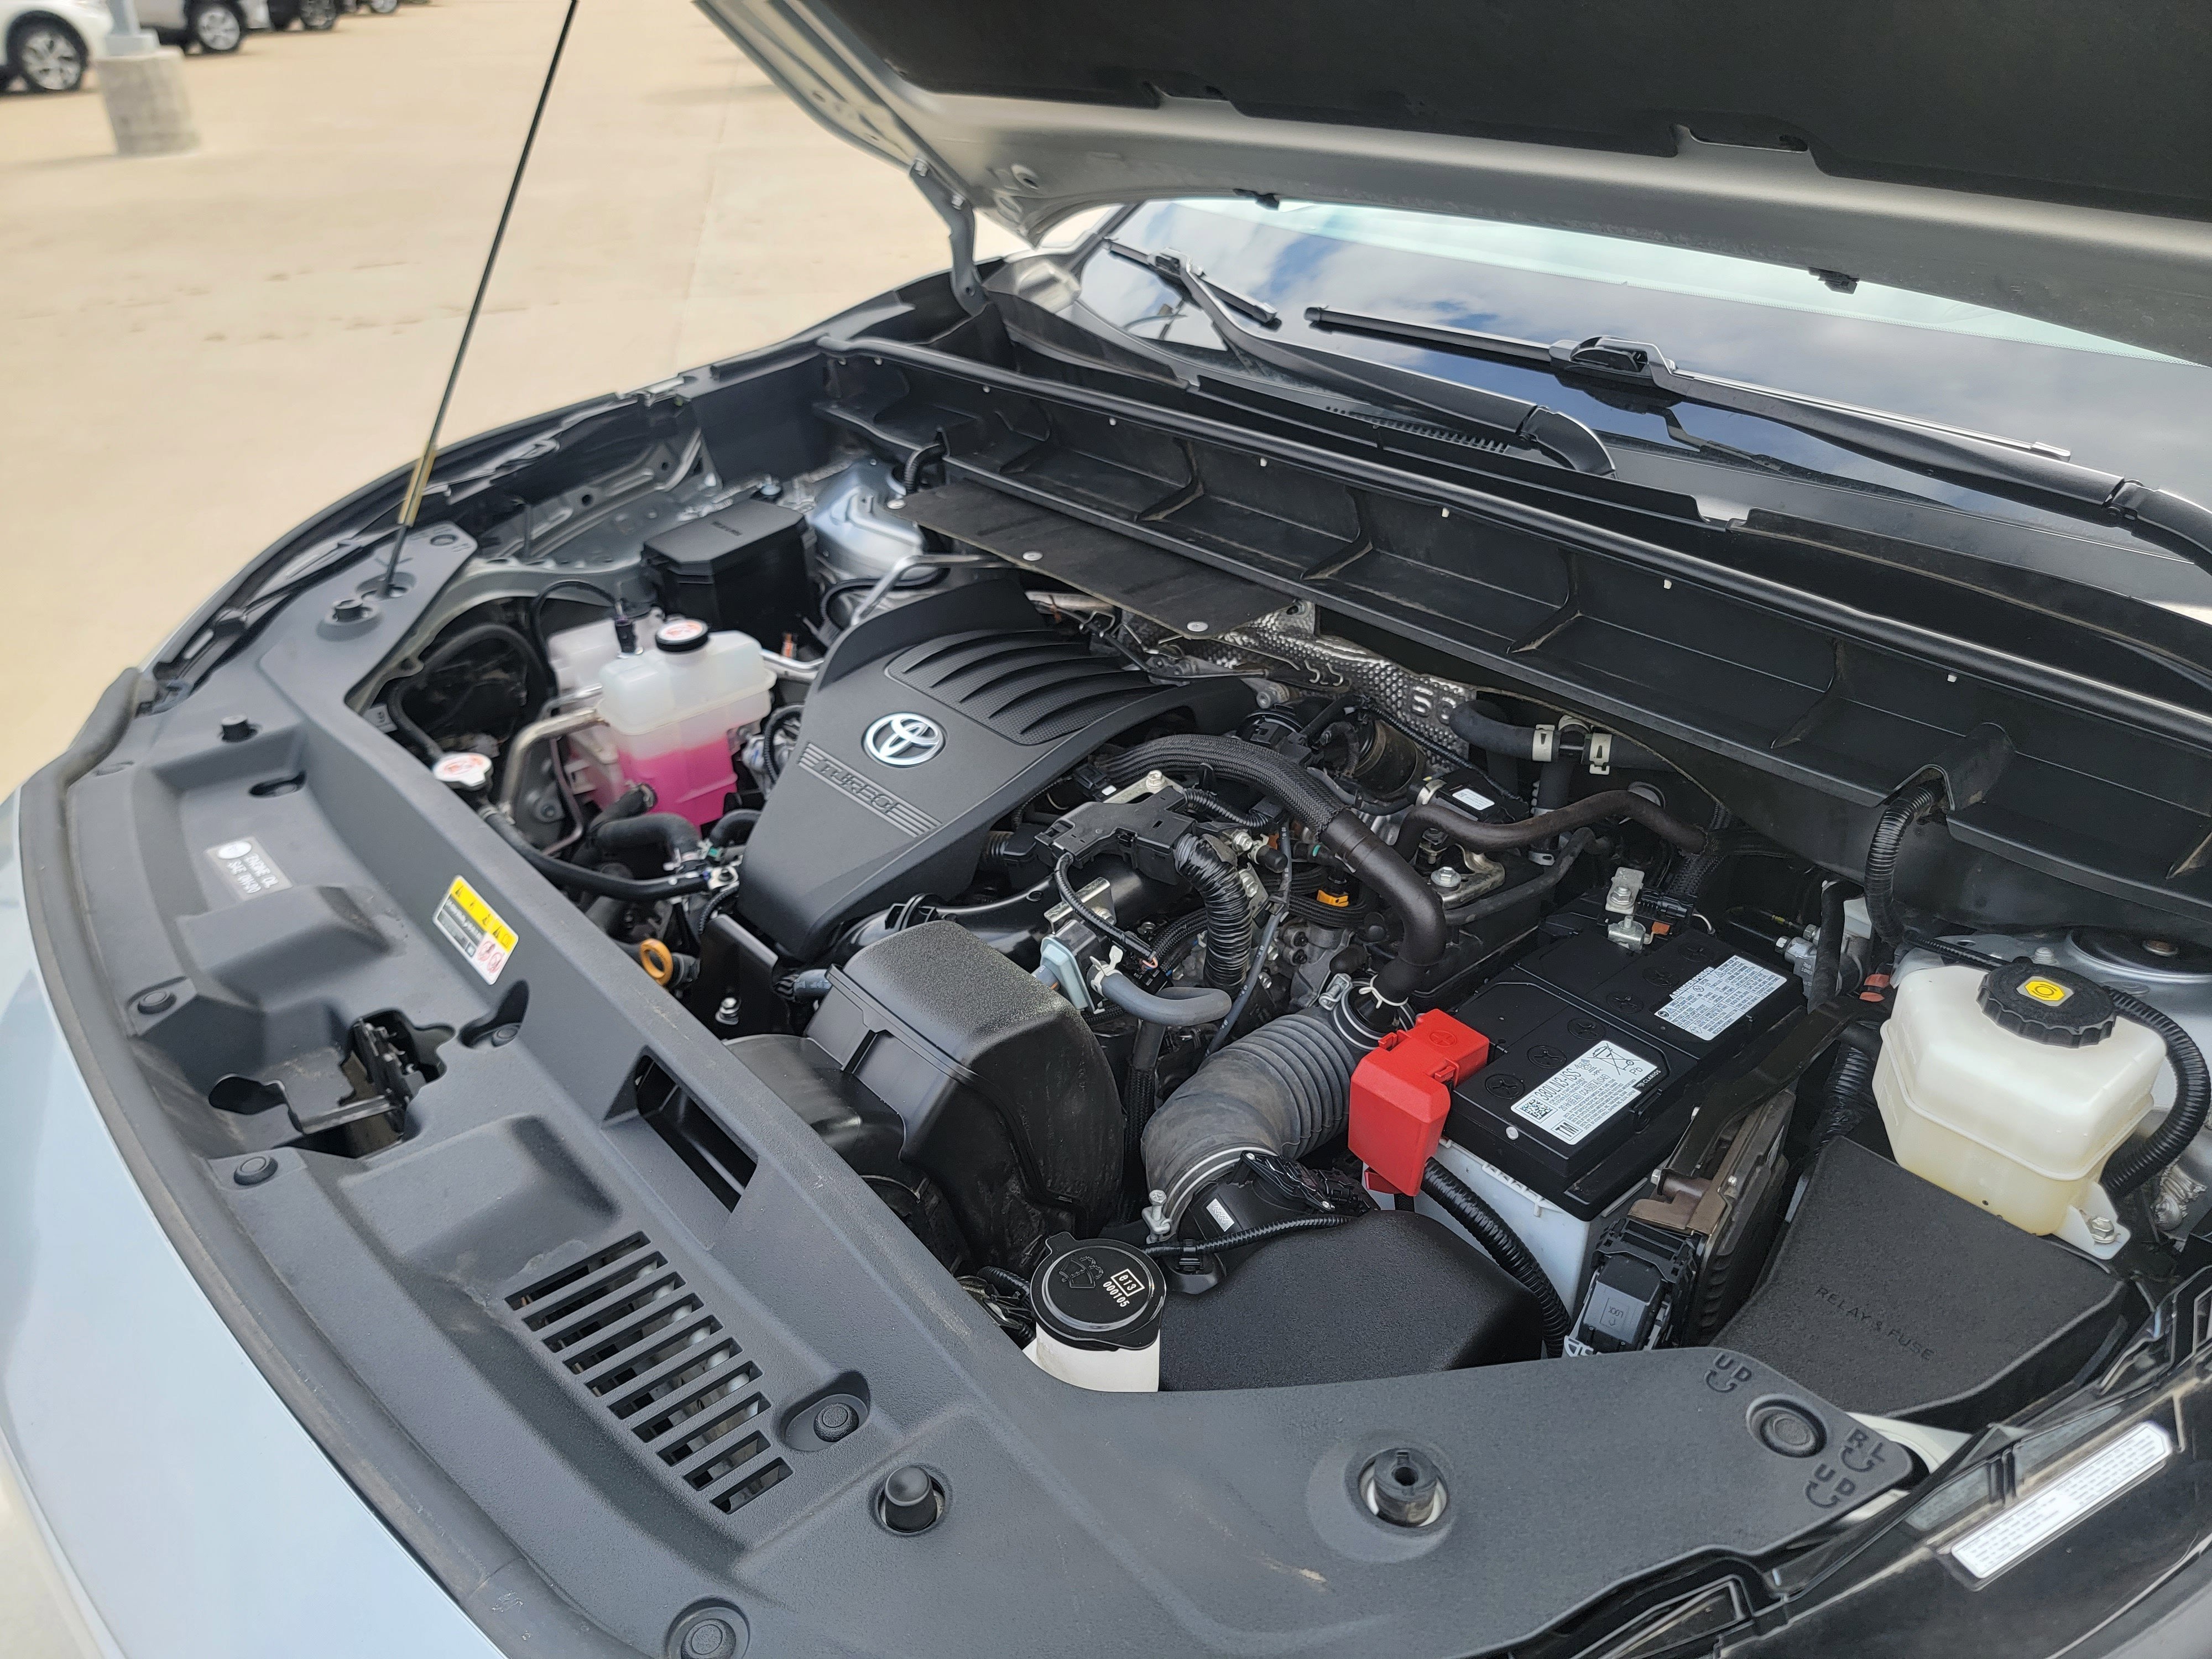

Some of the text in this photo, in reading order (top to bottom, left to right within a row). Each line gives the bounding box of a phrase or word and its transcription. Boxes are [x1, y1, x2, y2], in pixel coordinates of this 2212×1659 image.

[817, 761, 894, 811] TURBO
[1672, 966, 1714, 997] DANGER/POISON
[1629, 1066, 1643, 1076] Pb
[1642, 1070, 1662, 1084] CLARIOS
[1535, 1068, 1582, 1101] 380LN3-ISS
[1555, 1122, 1579, 1138] TM
[1103, 1281, 1131, 1307] 000105
[1119, 1275, 1138, 1292] e13
[1608, 1306, 1624, 1319] LOCK
[1814, 1287, 1872, 1322] RELAY
[1887, 1328, 1934, 1360] FUSE
